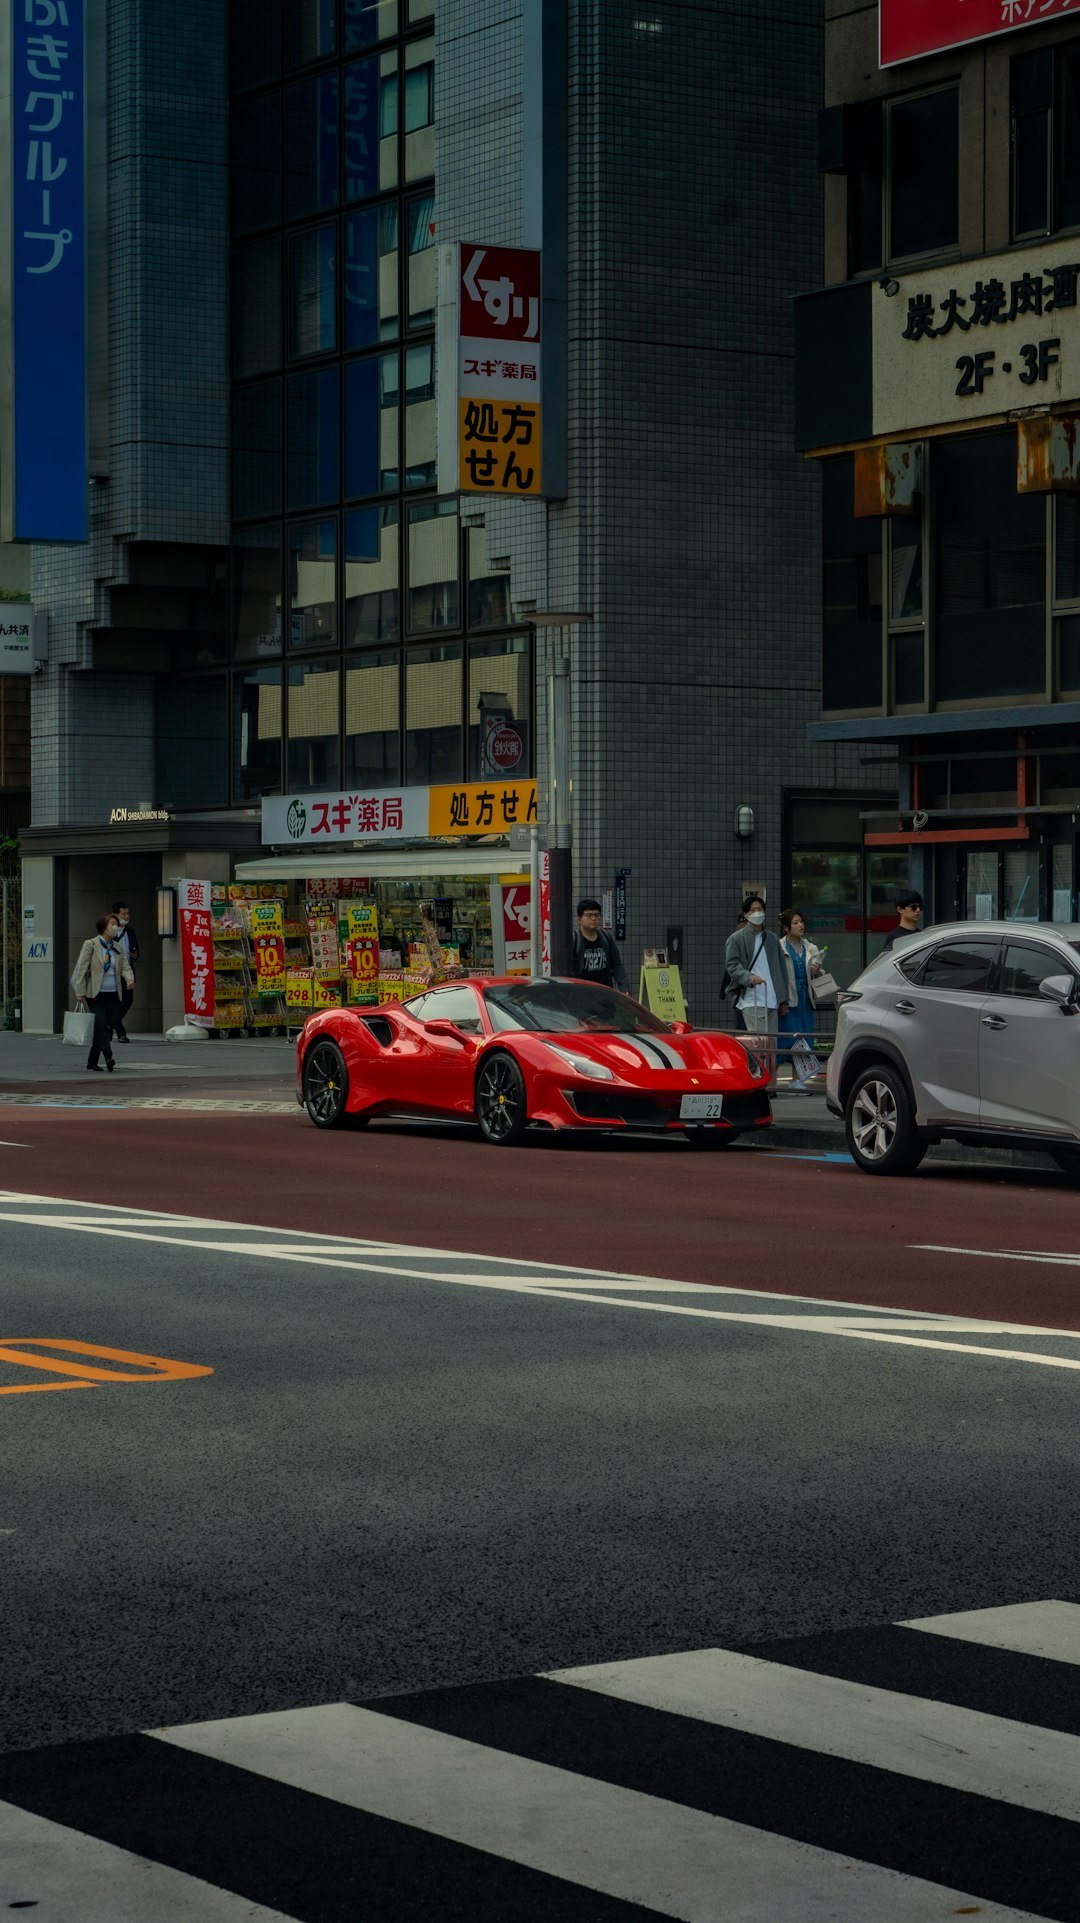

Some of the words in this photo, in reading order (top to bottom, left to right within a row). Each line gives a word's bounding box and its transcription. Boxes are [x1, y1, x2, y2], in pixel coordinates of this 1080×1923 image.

[462, 249, 539, 338] くすり
[902, 264, 1080, 340] 炭火焼肉酒
[463, 359, 537, 381] スギ薬局
[464, 401, 536, 446] 処方
[465, 449, 534, 489] せん
[110, 808, 127, 821] ACN
[127, 811, 158, 821] SHIBADAIMON
[311, 795, 403, 834] スギ薬局
[450, 788, 538, 827] 処方せん
[310, 878, 339, 893] 免税
[196, 914, 208, 926] Tax
[618, 929, 623, 937] 2
[28, 943, 48, 958] ACN
[260, 966, 280, 974] OFF
[356, 970, 376, 978] OFF
[287, 989, 309, 1001] 298
[315, 990, 337, 1001] 198
[379, 992, 399, 1002] 378
